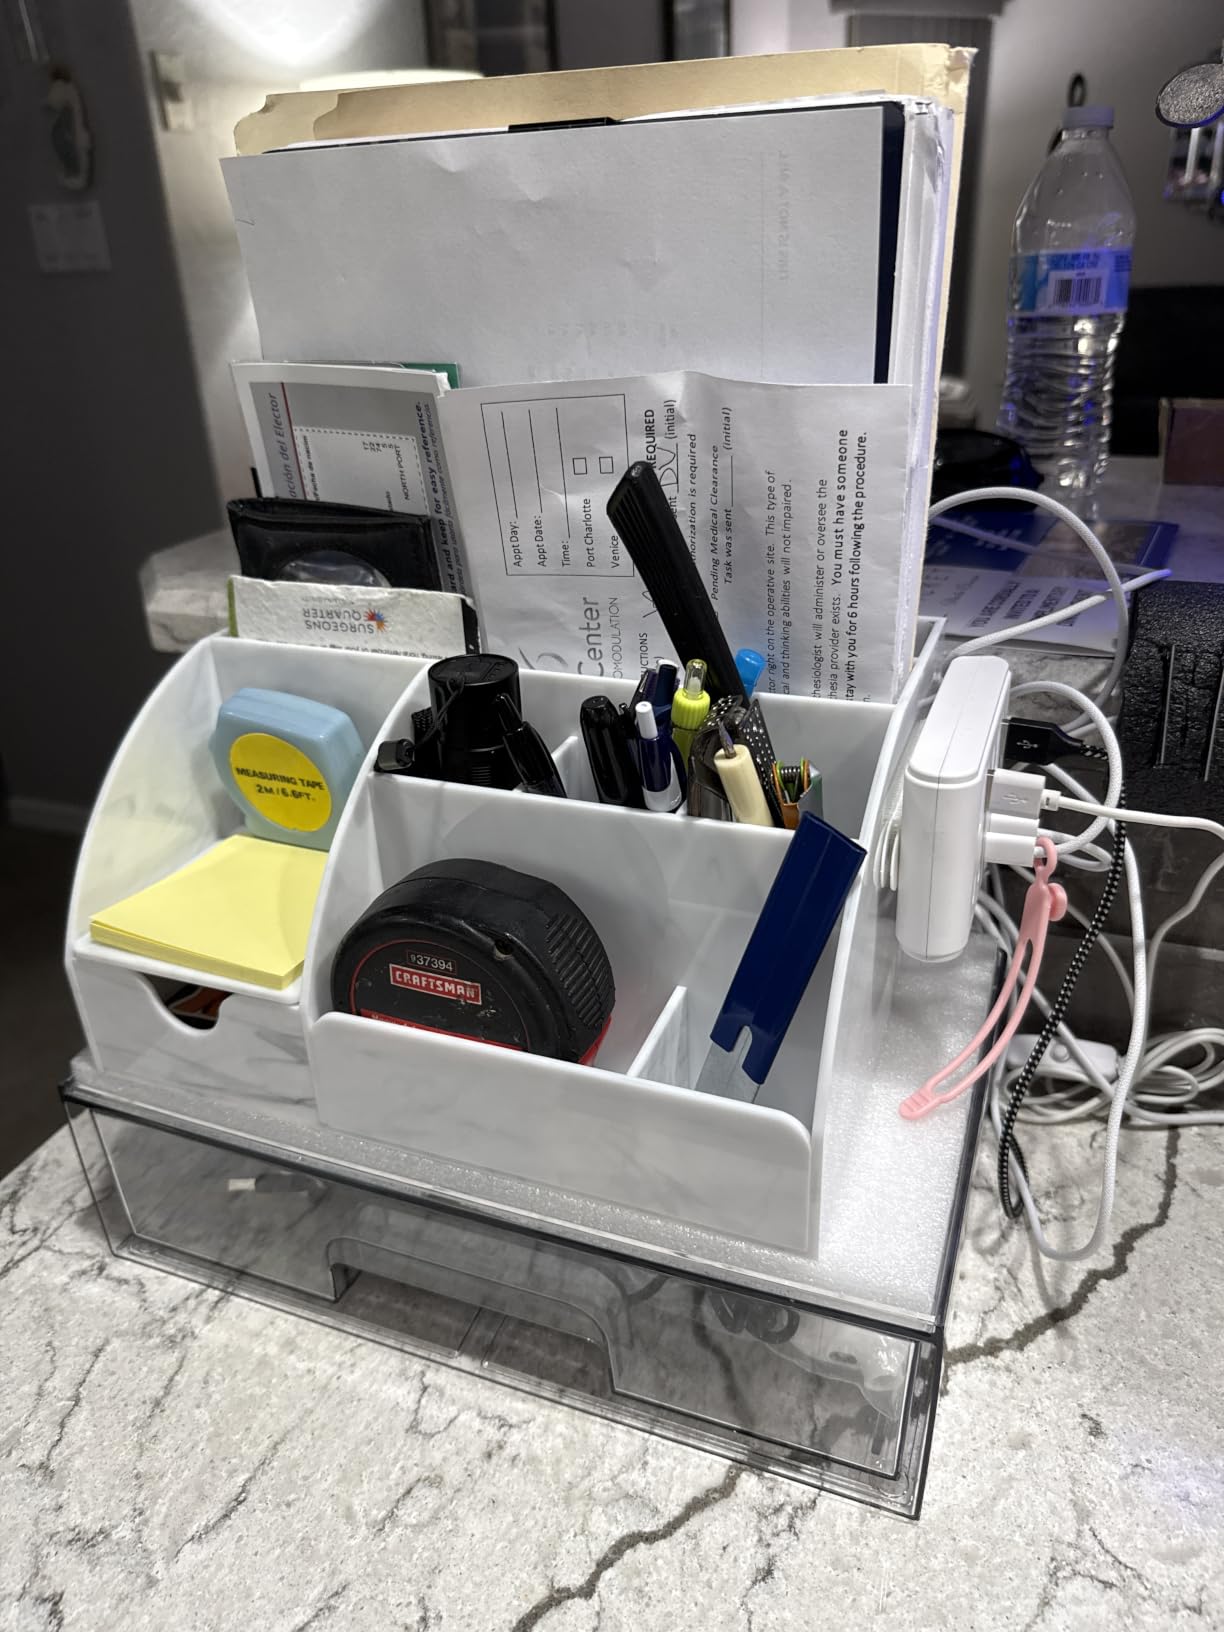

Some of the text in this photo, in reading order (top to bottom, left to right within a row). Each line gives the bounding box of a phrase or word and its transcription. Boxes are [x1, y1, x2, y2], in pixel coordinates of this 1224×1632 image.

[268, 393, 285, 438] Elector
[664, 400, 678, 439] (initial)
[722, 407, 732, 450] (initial)
[416, 402, 432, 463] reference.
[278, 442, 289, 460] del
[688, 434, 698, 485] required
[836, 430, 848, 490] someone
[394, 444, 410, 500] NORTH PORT
[765, 470, 775, 483] of
[853, 432, 867, 498] procedure.
[428, 466, 438, 494] easy
[688, 488, 696, 497] is
[816, 479, 827, 498] the
[434, 498, 442, 514] for
[766, 486, 776, 510] type
[833, 494, 845, 524] have
[852, 501, 863, 521] the
[438, 519, 448, 545] keep
[582, 498, 595, 568] Port Charlotte
[710, 445, 720, 600] Pending Medical Clearance
[724, 509, 732, 532] sent
[765, 515, 774, 536] This
[817, 503, 826, 546] oversee
[510, 522, 522, 567] Appt Day:
[534, 516, 548, 567] Appt Date:
[562, 540, 570, 567] Time:
[610, 535, 620, 568] Venice
[766, 544, 775, 564] site.
[782, 534, 790, 553] not
[816, 548, 824, 561] or
[834, 528, 844, 560] must
[848, 523, 865, 575] following
[442, 549, 454, 570] and
[724, 560, 732, 584] Task
[781, 557, 790, 575] will
[831, 563, 842, 585] You
[766, 569, 775, 616] operative
[781, 580, 790, 618] abilities
[812, 565, 824, 620] administer
[847, 578, 860, 609] hours
[302, 608, 362, 622] QUARTER
[830, 594, 840, 624] exists.
[304, 620, 374, 634] SURGEONS
[578, 597, 604, 676] Center
[766, 620, 775, 635] the
[781, 620, 792, 659] thinking
[812, 624, 822, 640] will
[845, 620, 857, 636] for
[767, 638, 775, 650] on
[829, 628, 840, 670] provider
[847, 638, 857, 658] you
[766, 653, 776, 674] right
[781, 662, 790, 679] and
[845, 660, 855, 681] with
[236, 767, 325, 790] MEASURING TAPE
[410, 954, 453, 972] 937394
[395, 971, 475, 998] CRAFTSMAN
